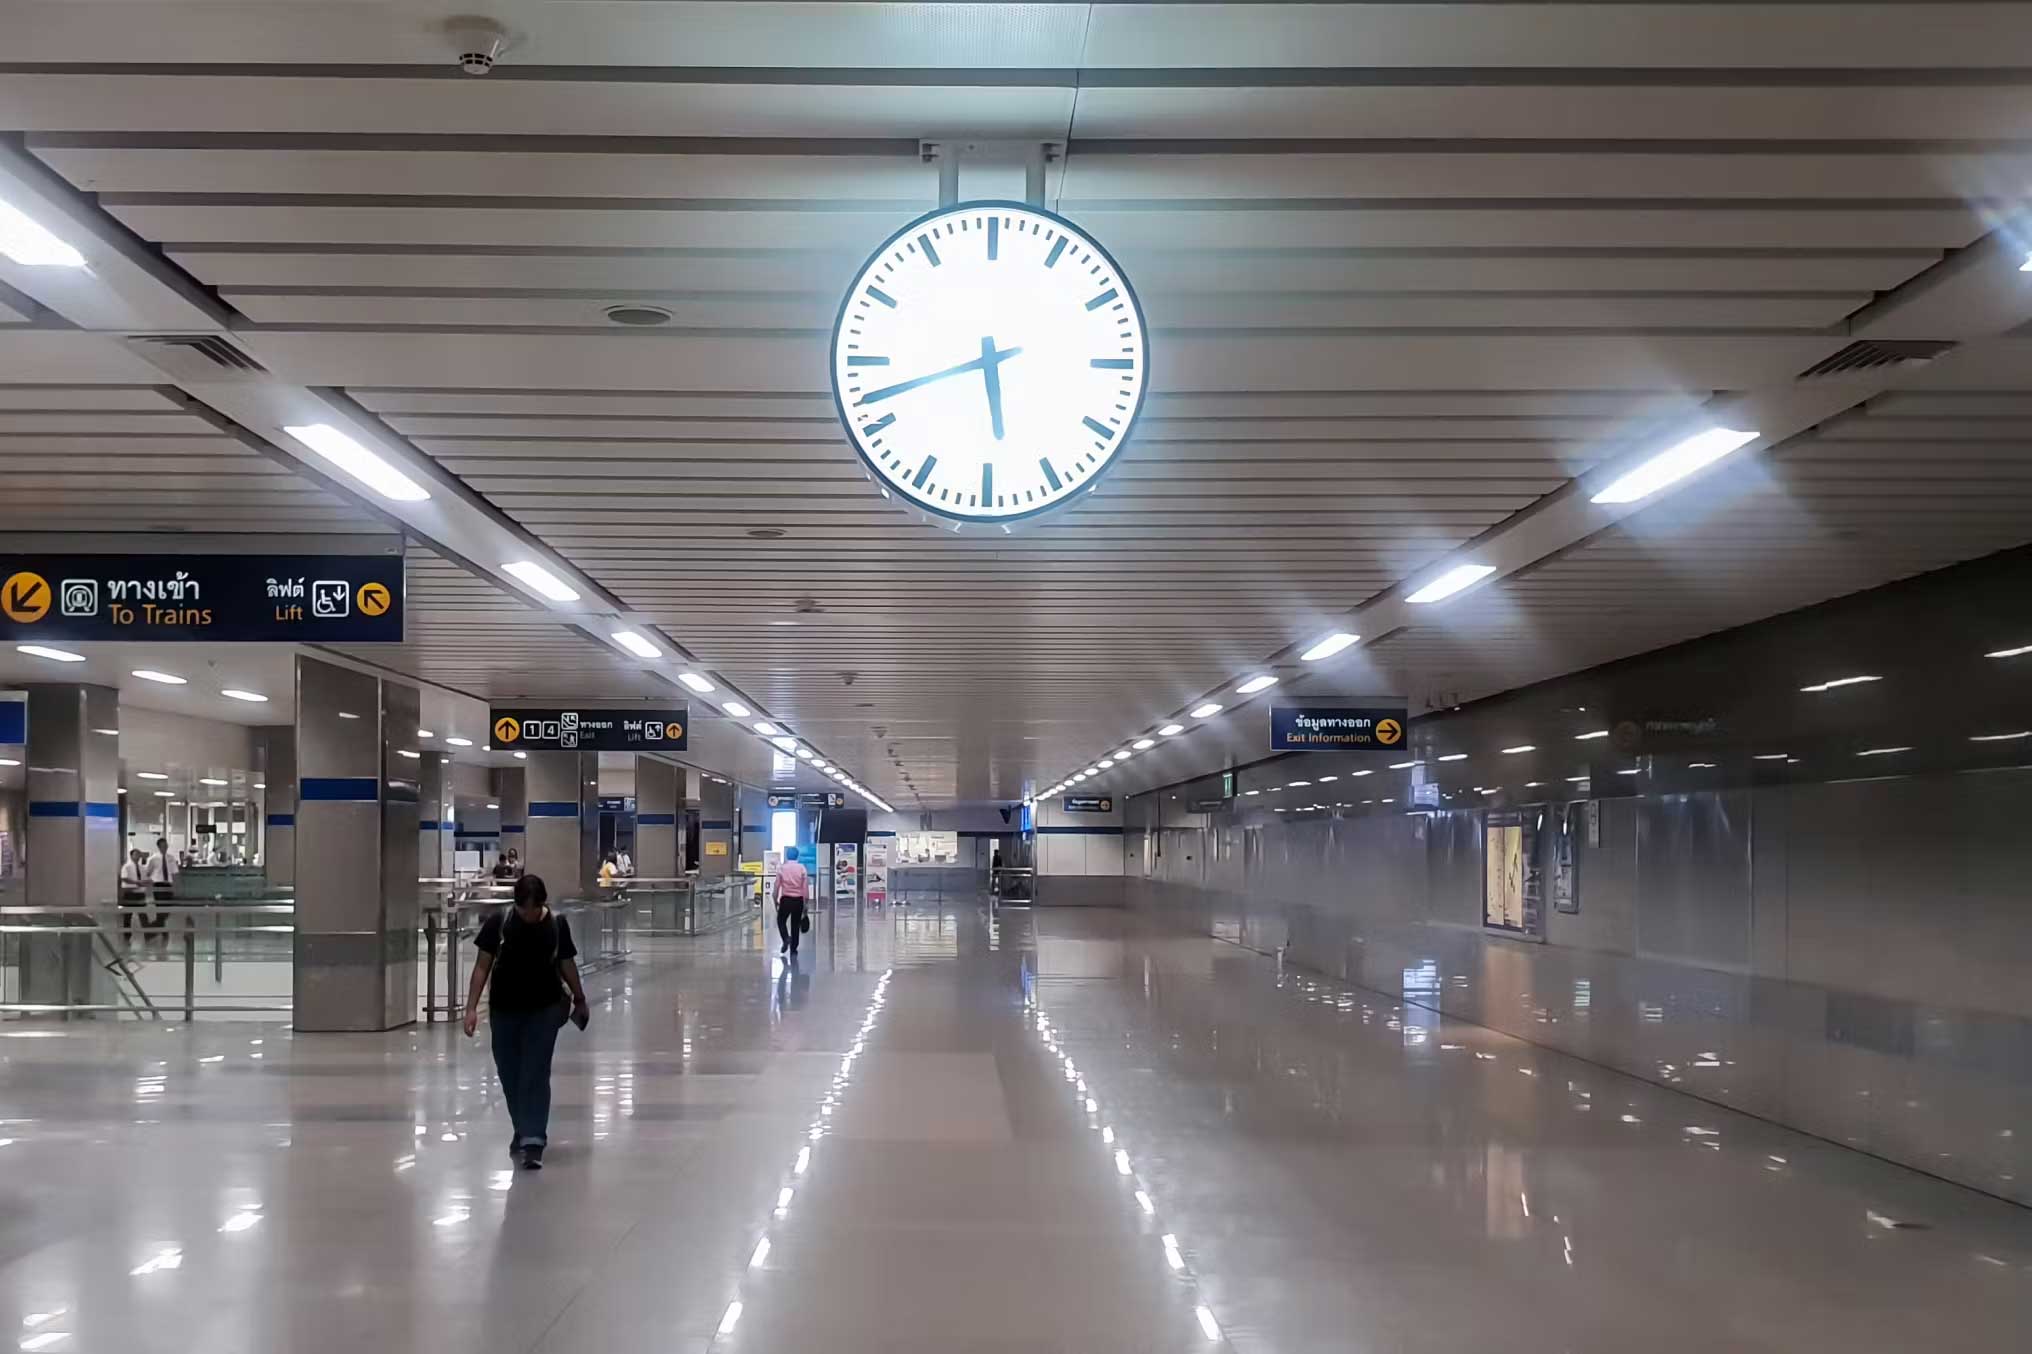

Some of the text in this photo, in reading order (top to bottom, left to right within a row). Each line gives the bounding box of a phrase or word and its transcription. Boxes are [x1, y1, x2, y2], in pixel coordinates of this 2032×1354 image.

[107, 571, 200, 600] ทางเข้า
[266, 577, 305, 599] ลิฟต์
[109, 604, 212, 625] To Trains
[275, 605, 303, 621] Lift
[1295, 715, 1371, 731] ข้อมูลทางออก
[1286, 733, 1371, 743] Exit Information
